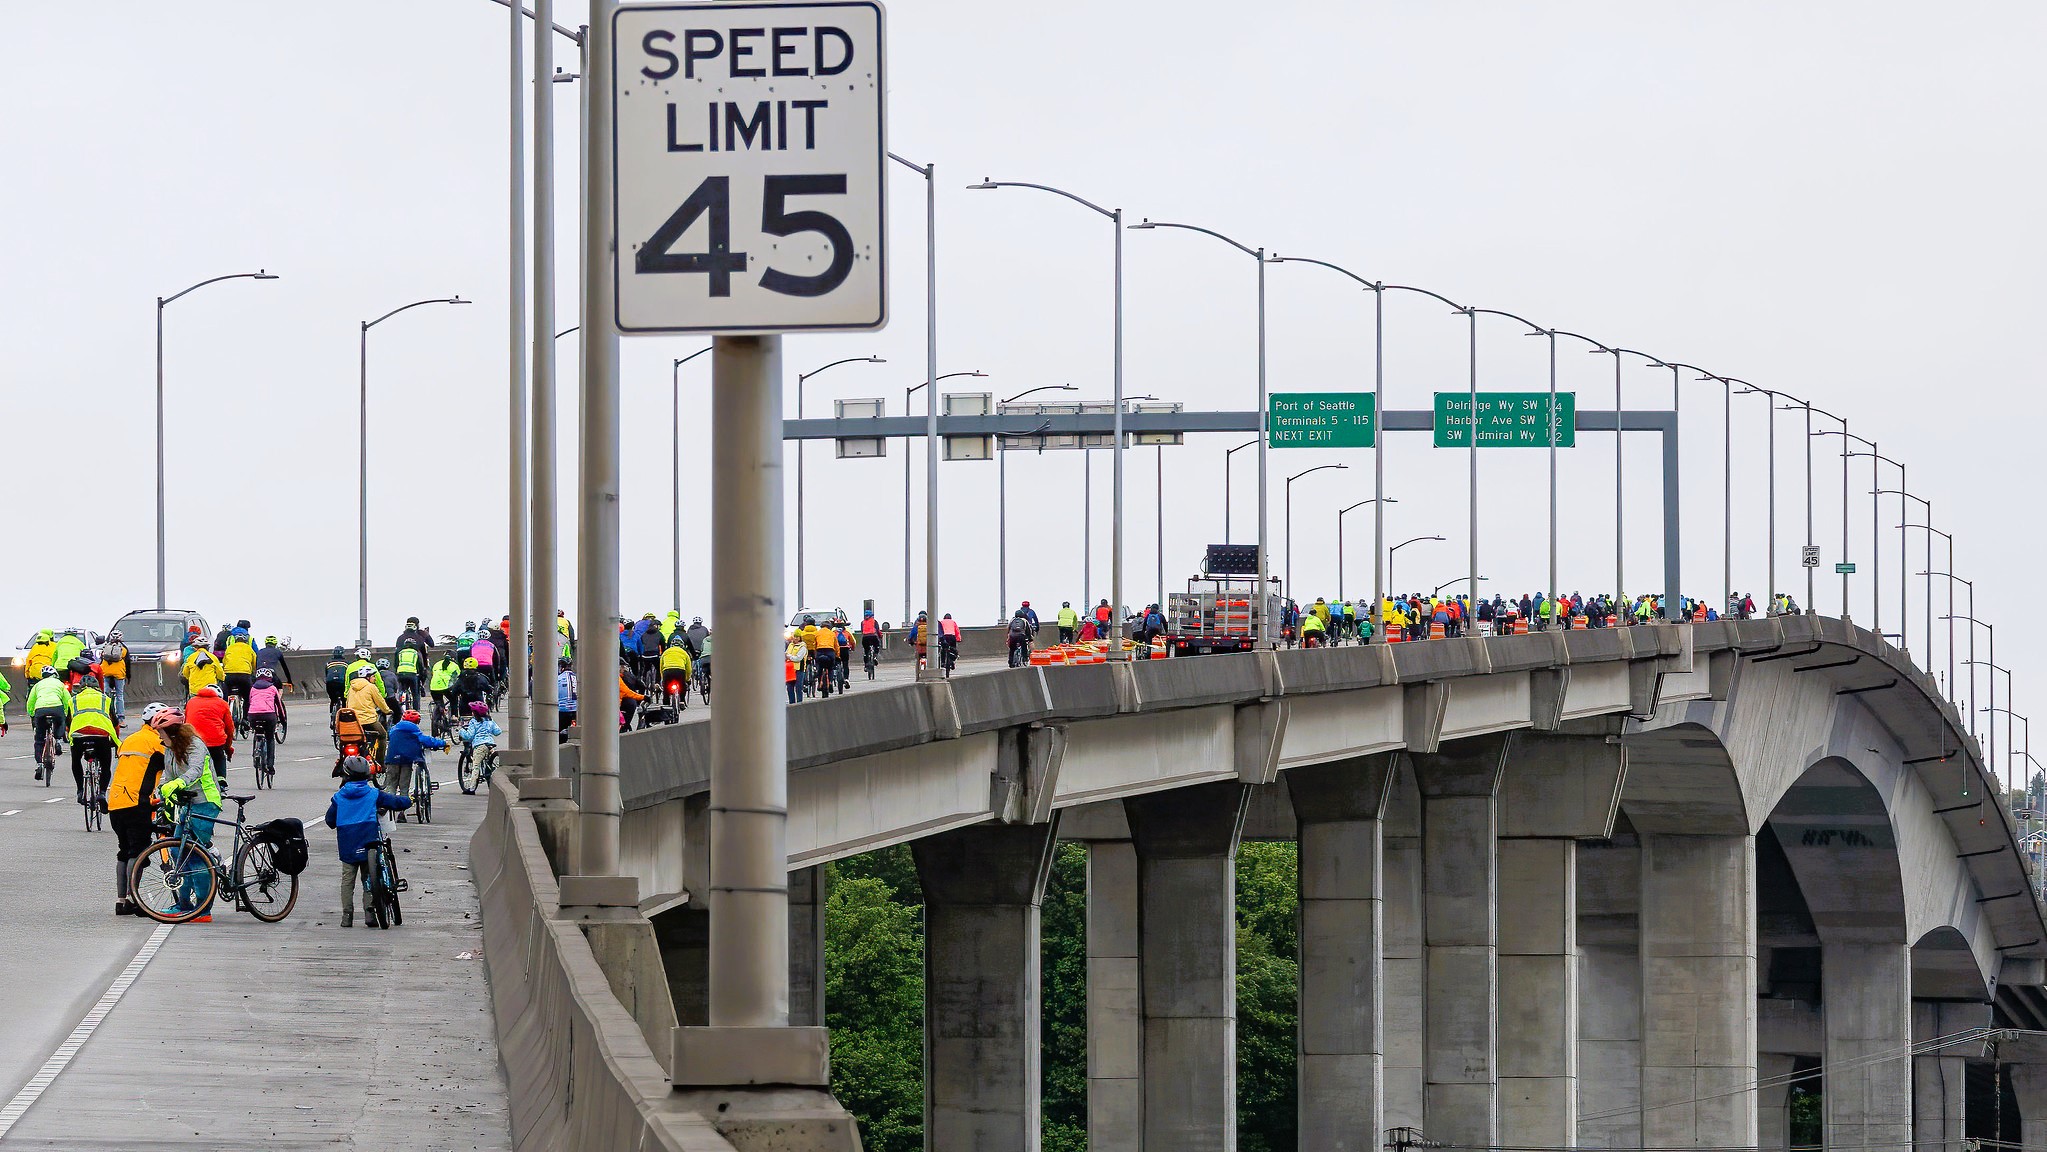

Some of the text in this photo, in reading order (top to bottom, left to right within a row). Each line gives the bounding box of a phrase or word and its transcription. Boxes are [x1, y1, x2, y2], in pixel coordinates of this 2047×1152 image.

[640, 26, 854, 80] SPEED
[667, 100, 828, 152] LIMIT
[635, 174, 855, 297] 45
[1275, 401, 1355, 411] Port of Seattle
[1499, 400, 1514, 412] Wy
[1522, 400, 1538, 410] SW
[1276, 415, 1326, 426] Terminals
[1331, 415, 1338, 425] 5
[1353, 415, 1369, 425] 115
[1491, 415, 1513, 425] Ave
[1519, 415, 1536, 425] SW
[1275, 430, 1333, 441] NEXT EXIT
[1446, 430, 1463, 440] SW
[1474, 430, 1513, 440] dmiral
[1519, 430, 1536, 442] Wy
[1803, 556, 1818, 565] 45
